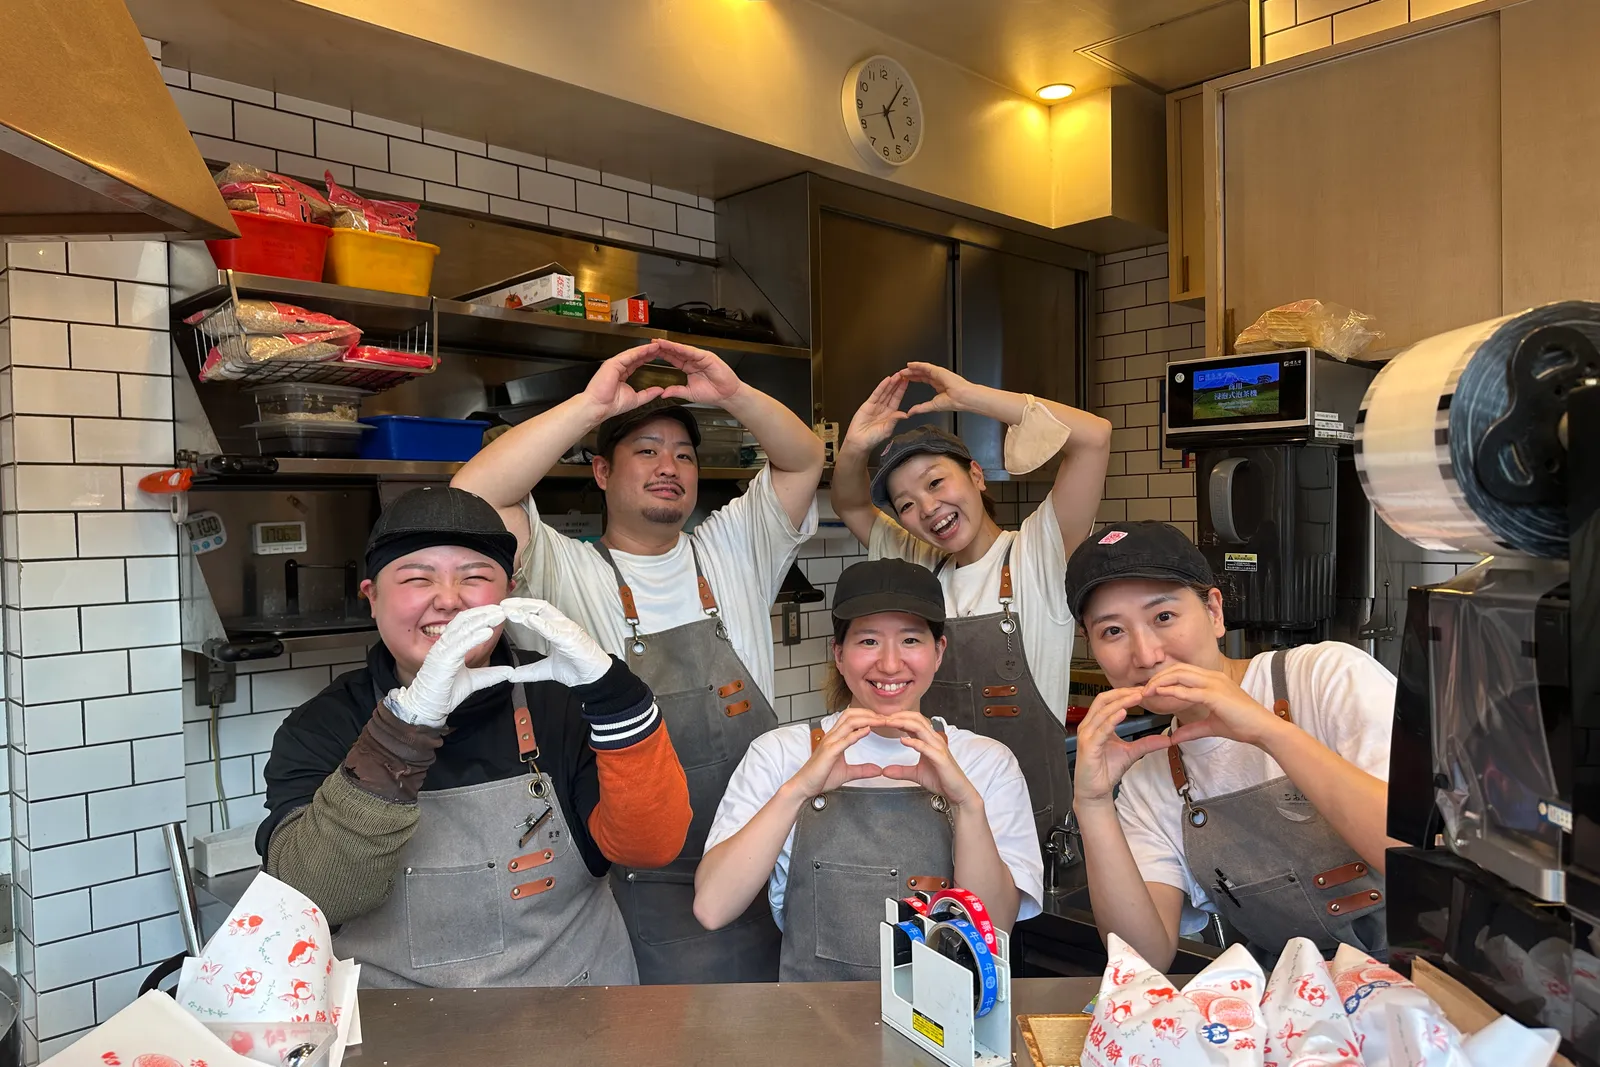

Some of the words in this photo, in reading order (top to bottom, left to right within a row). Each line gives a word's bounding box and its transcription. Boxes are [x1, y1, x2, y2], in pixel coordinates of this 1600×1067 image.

[869, 70, 875, 81] 11
[880, 69, 888, 80] 12
[860, 81, 868, 92] 10
[856, 99, 863, 109] 9
[902, 97, 909, 107] 2
[861, 119, 867, 129] 8
[906, 117, 912, 126] 3
[870, 136, 876, 146] 7
[903, 134, 910, 143] 4
[883, 147, 889, 156] 6
[895, 145, 902, 155] 5
[969, 931, 980, 941] 牛
[984, 963, 993, 974] 牛
